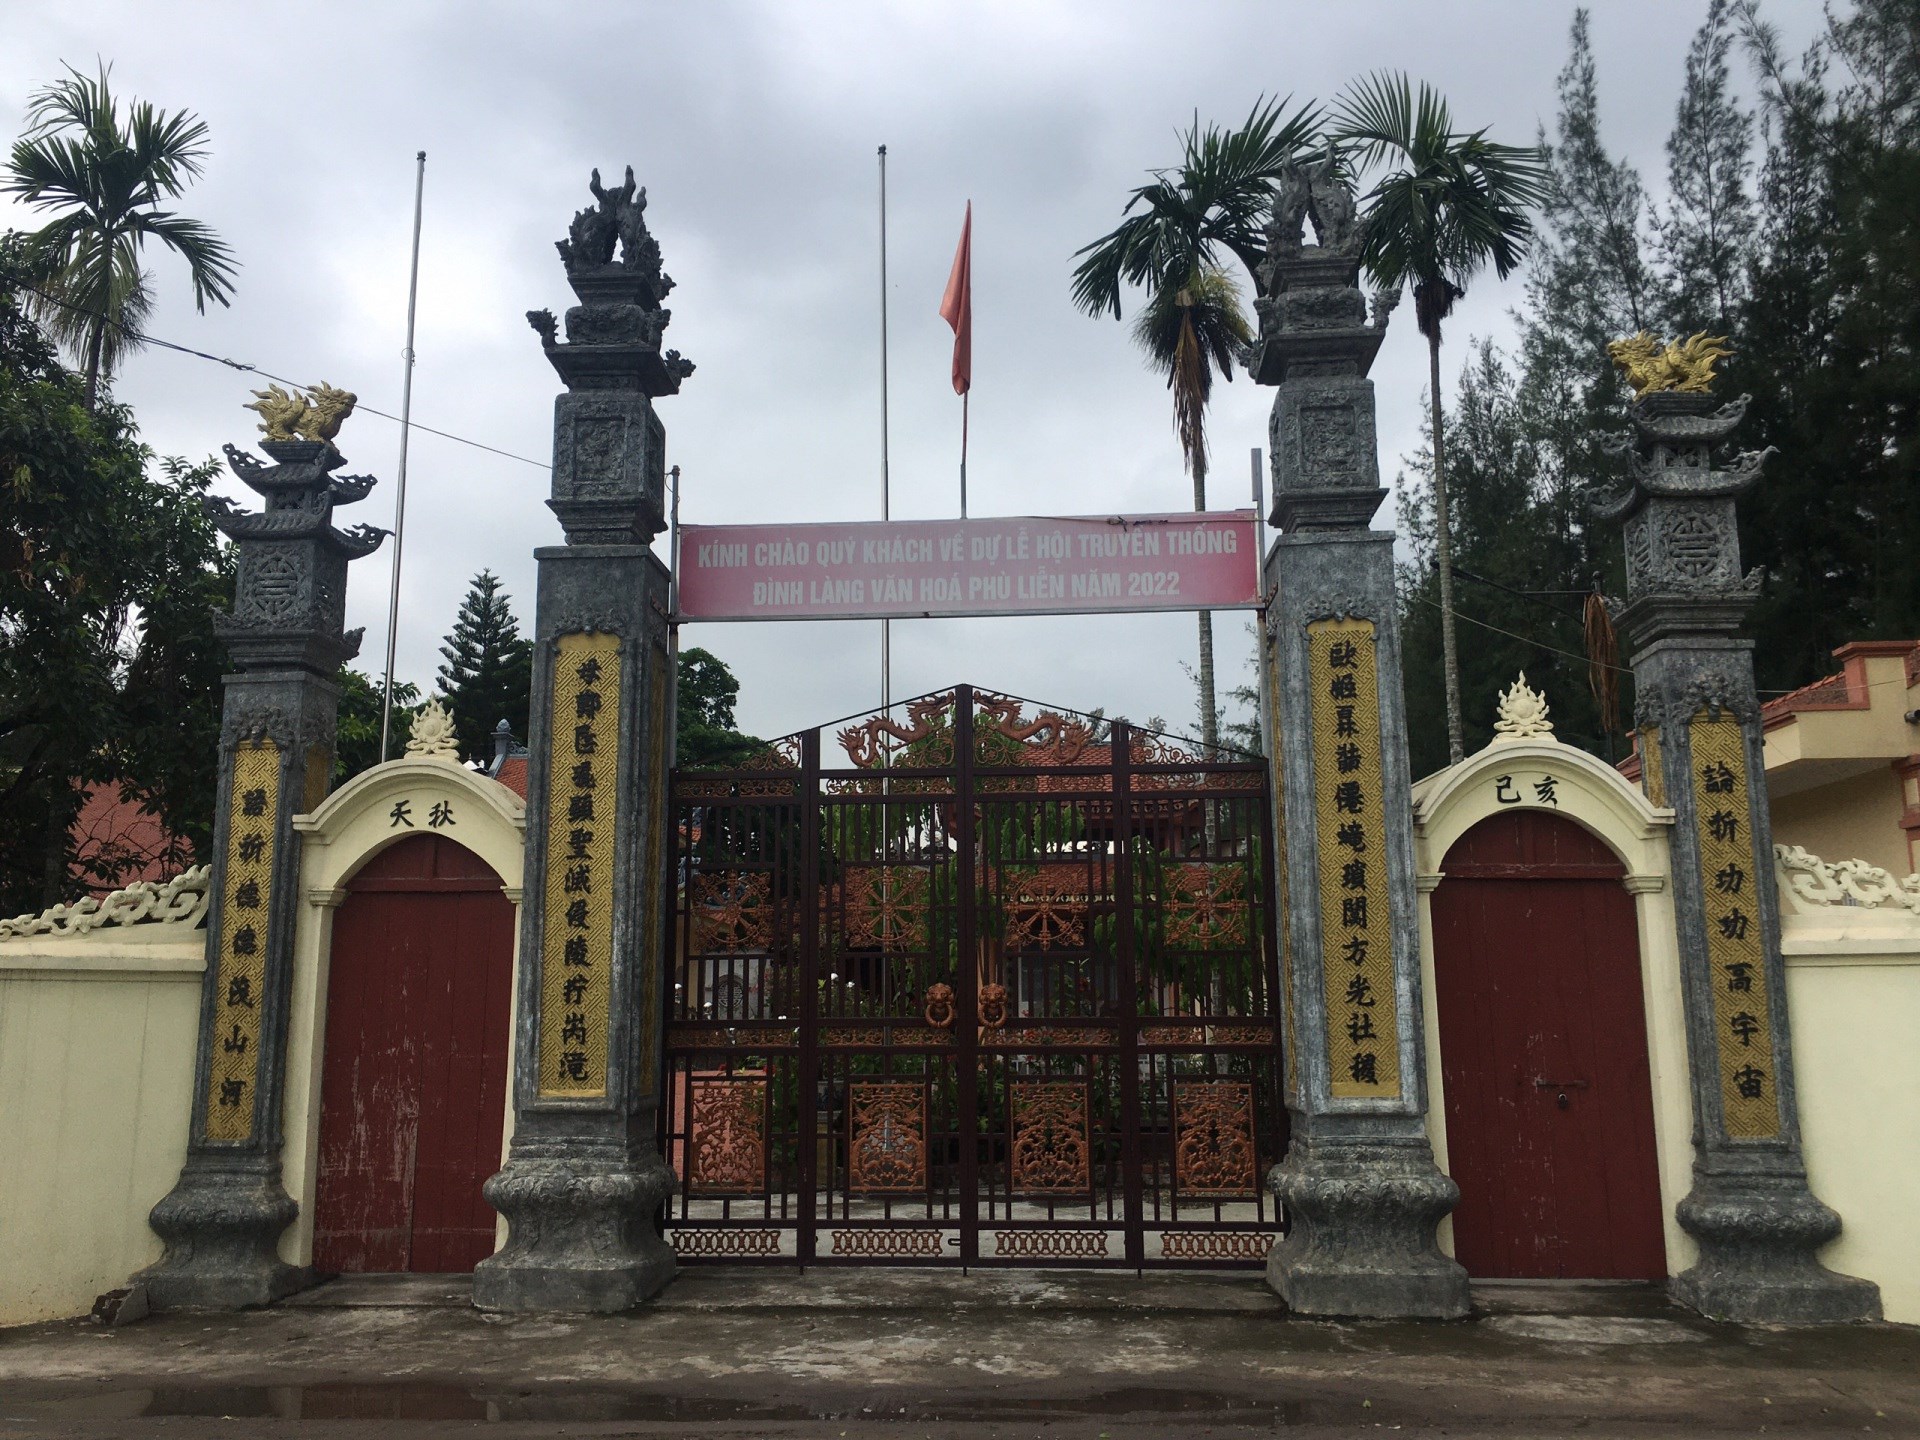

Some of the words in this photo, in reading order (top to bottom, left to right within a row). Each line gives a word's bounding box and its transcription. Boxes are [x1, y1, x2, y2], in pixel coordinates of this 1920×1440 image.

[698, 539, 748, 567] KÍNH
[754, 538, 810, 567] CHÀO
[816, 535, 856, 568] QUÝ
[863, 534, 933, 564] KHÁCH
[971, 534, 1002, 566] DỰ
[1006, 526, 1029, 560] LỄ
[1036, 530, 1072, 564] HỘI
[1166, 522, 1237, 554] THỐNG
[753, 577, 803, 606] ĐÌNH
[809, 575, 865, 604] LÀNG
[871, 574, 913, 603] VĂN
[919, 572, 963, 602] HOÁ
[1017, 565, 1065, 599] LIỄN
[1071, 568, 1122, 598] NĂM
[1127, 571, 1180, 597] 2022
